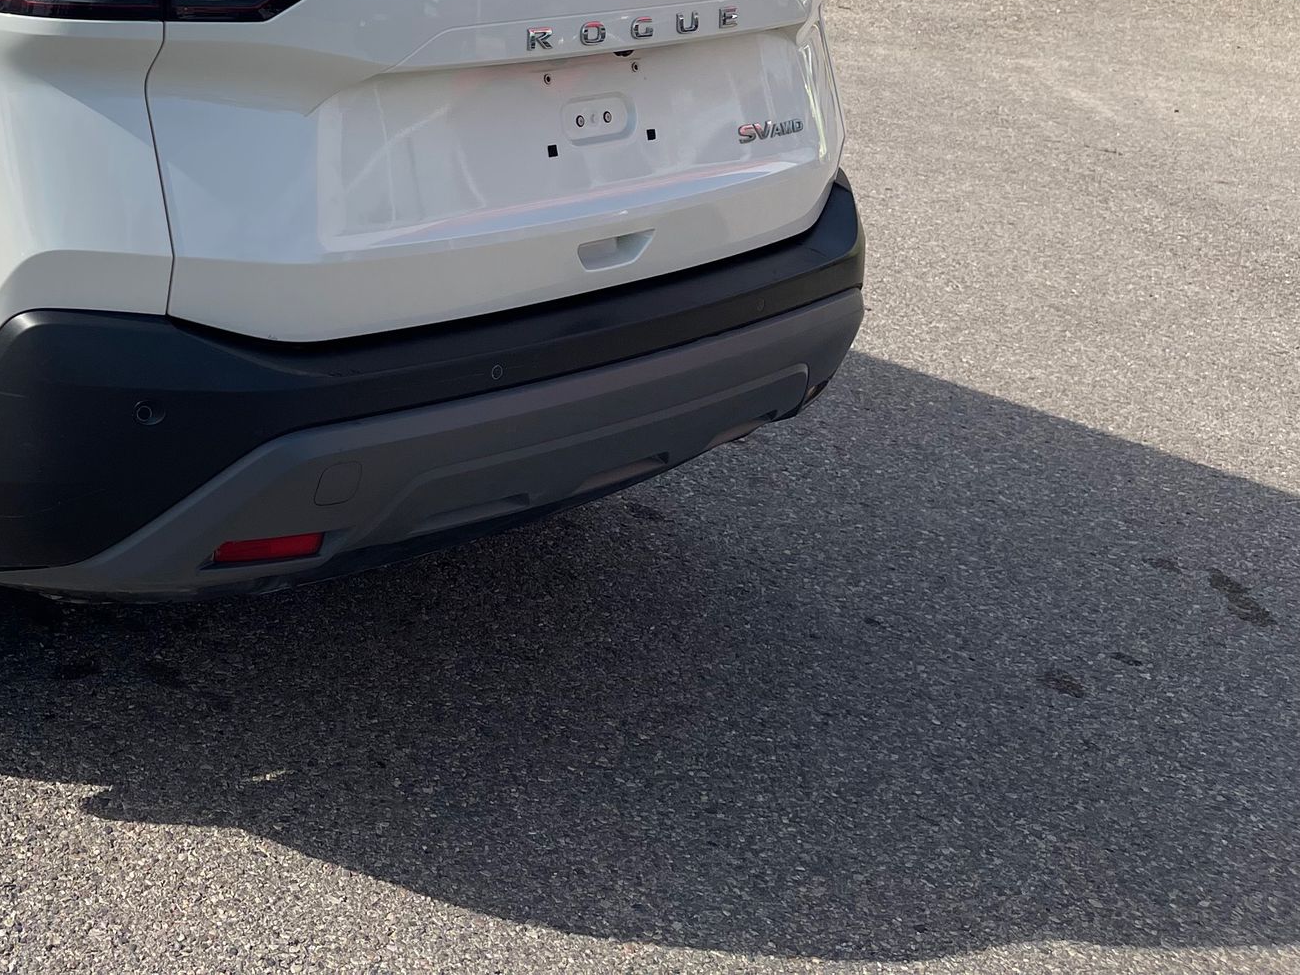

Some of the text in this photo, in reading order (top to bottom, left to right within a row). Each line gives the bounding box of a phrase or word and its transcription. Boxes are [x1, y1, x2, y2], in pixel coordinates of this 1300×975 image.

[526, 5, 739, 51] ROGUE
[738, 118, 804, 144] SV AWD
